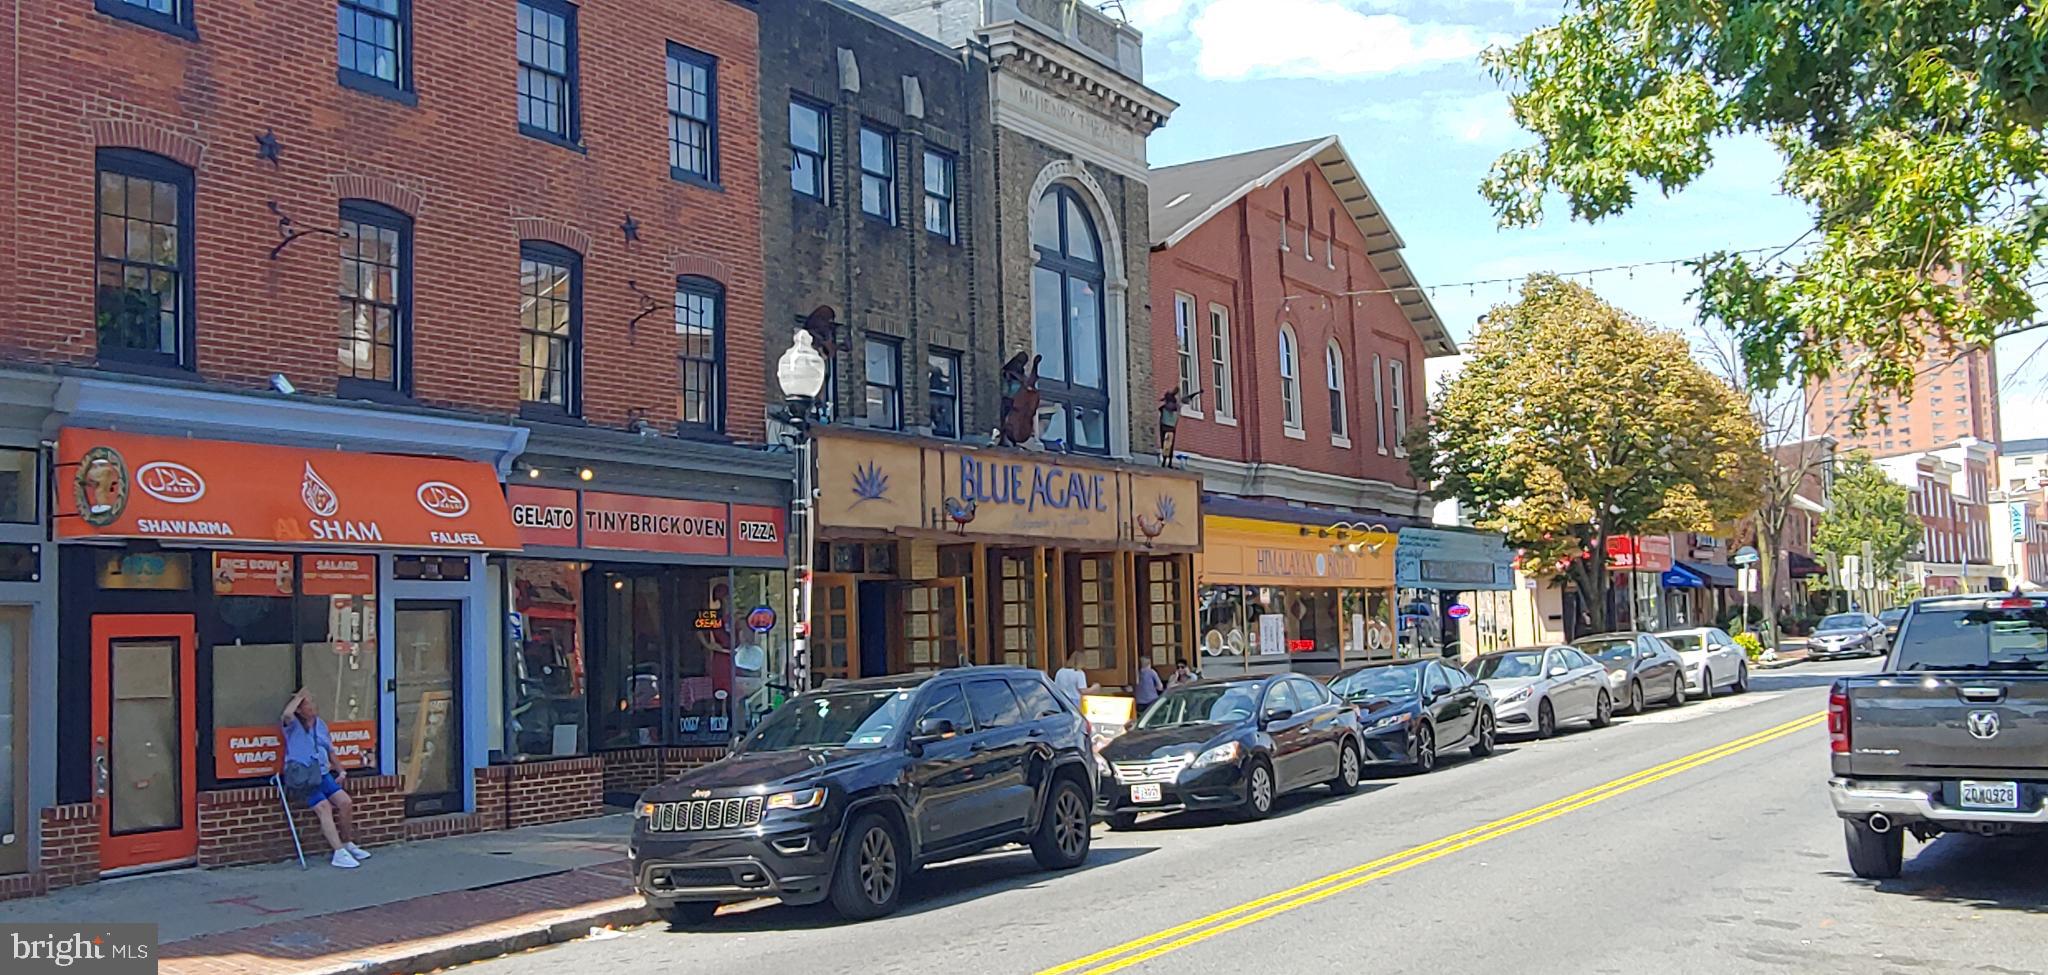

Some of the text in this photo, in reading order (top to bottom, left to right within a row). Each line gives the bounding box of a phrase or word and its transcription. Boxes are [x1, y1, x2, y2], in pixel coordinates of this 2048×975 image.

[960, 454, 1107, 513] BLUE AGAVE
[512, 505, 574, 529] GELATO
[584, 510, 727, 538] TINYBRICKOVEN
[138, 519, 234, 536] SHAWARMA
[309, 519, 382, 541] SHAM
[739, 520, 777, 542] PIZZA
[430, 531, 484, 545] FALAFEL
[220, 558, 290, 571] RICE BOWLS
[316, 560, 359, 571] SALADS
[230, 736, 280, 749] FALAFEL
[234, 751, 277, 764] WRAPS
